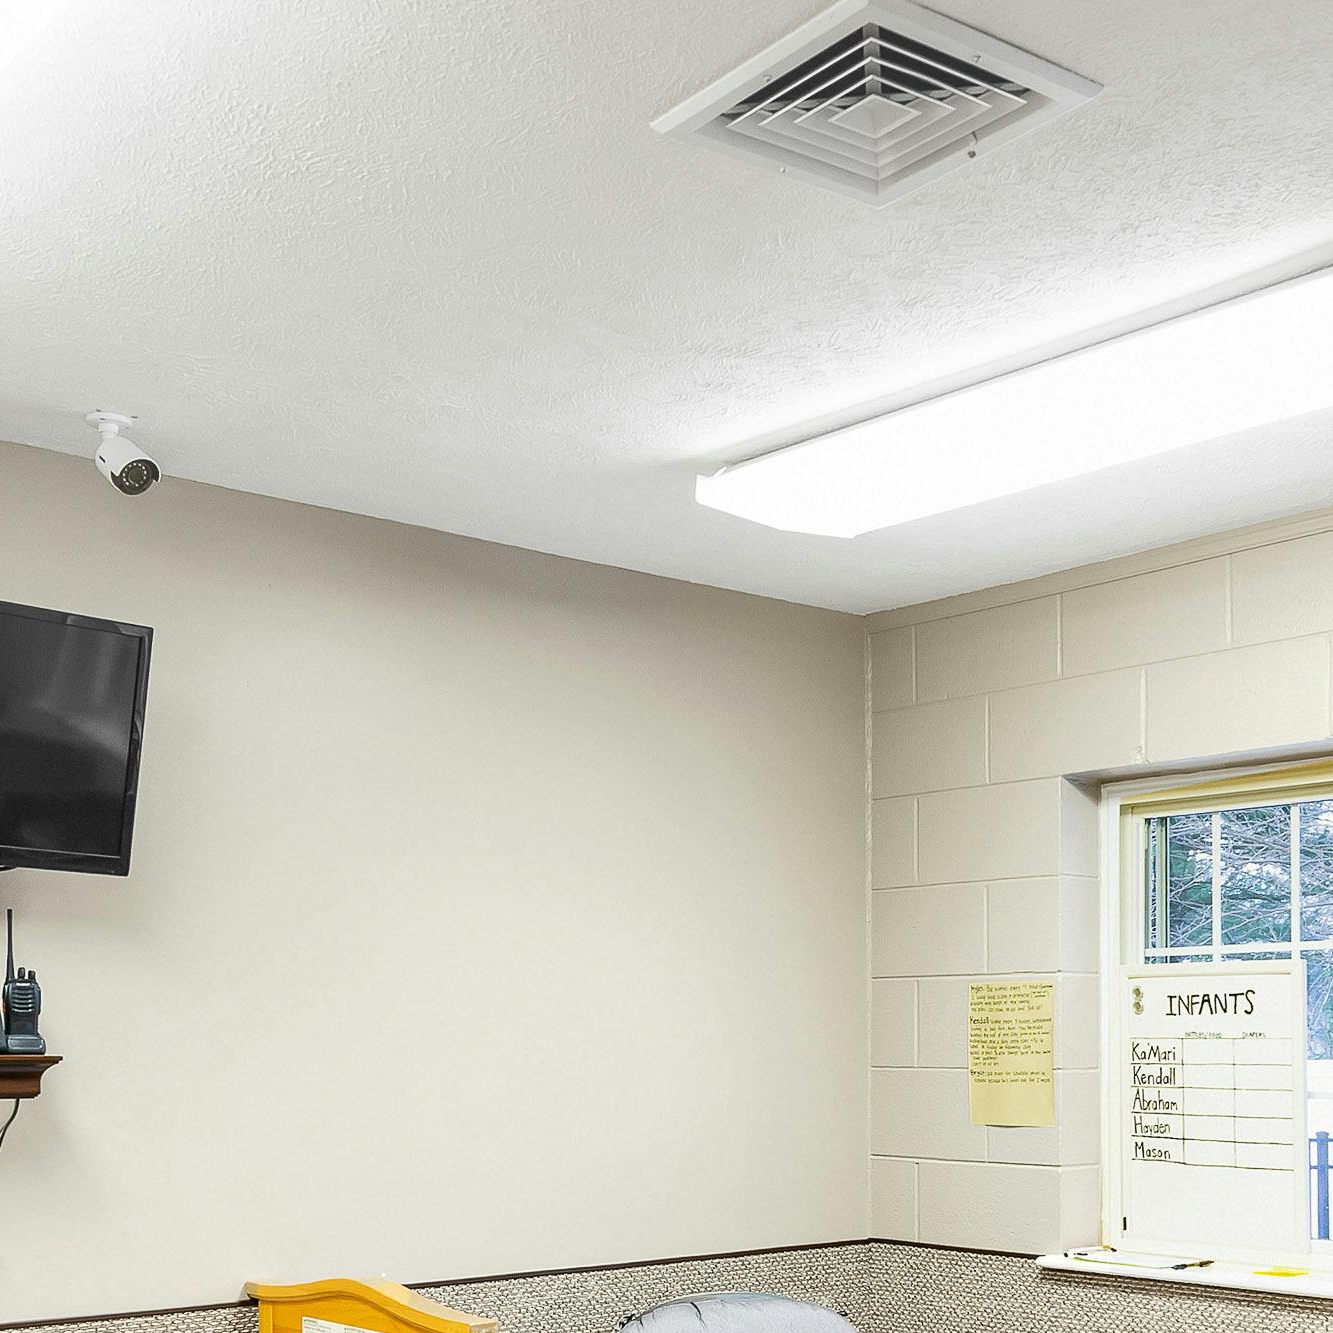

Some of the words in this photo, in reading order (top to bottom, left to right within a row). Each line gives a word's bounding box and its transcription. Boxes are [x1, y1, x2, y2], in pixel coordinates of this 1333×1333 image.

[1165, 989, 1256, 1016] INFANTS
[1131, 1041, 1176, 1061] Ka'Mari
[1133, 1066, 1176, 1085] Kendall
[1132, 1088, 1178, 1111] Abraham
[1133, 1115, 1171, 1136] Hayden
[1134, 1141, 1172, 1160] Mason
